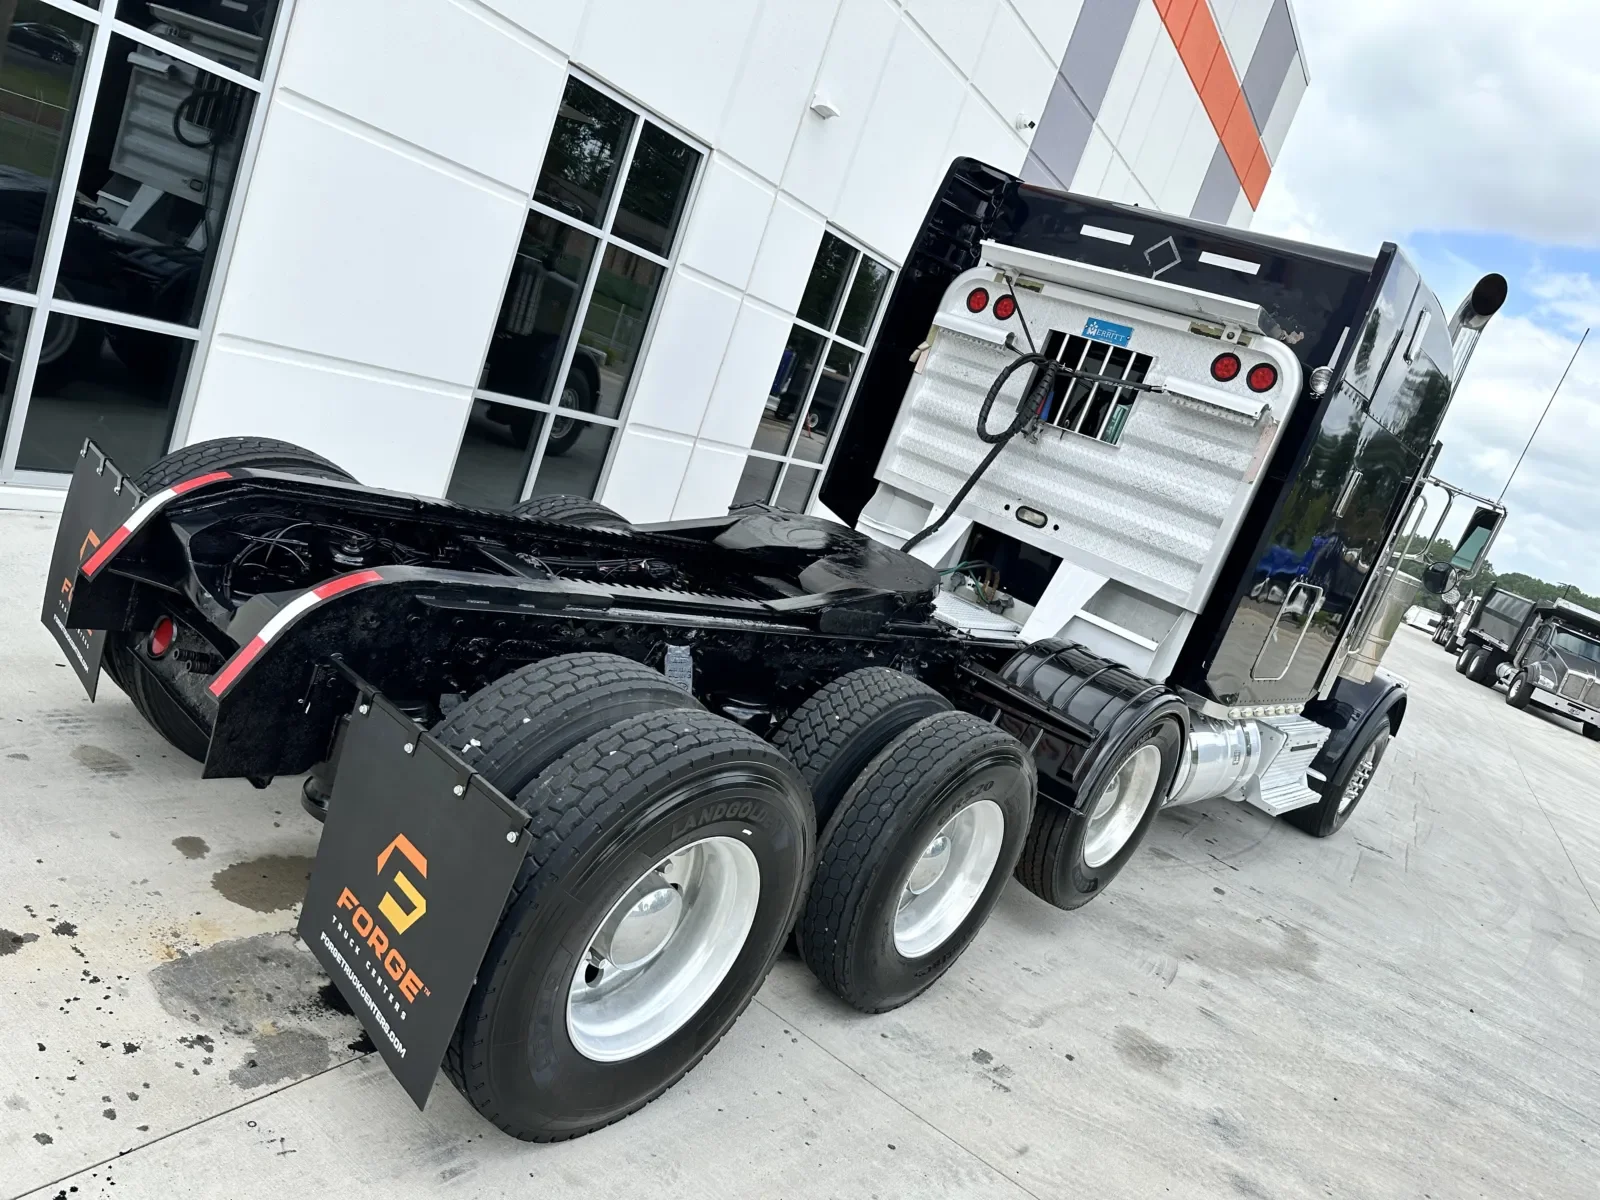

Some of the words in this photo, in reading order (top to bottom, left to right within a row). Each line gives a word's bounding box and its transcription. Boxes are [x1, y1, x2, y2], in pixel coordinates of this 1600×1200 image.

[1086, 325, 1126, 342] MERRITT
[320, 931, 407, 1059] FORGETRUCKCENTERS.COM
[332, 915, 360, 955] TRUCK
[365, 960, 407, 1021] CENTERS
[336, 887, 425, 1004] FORGE
